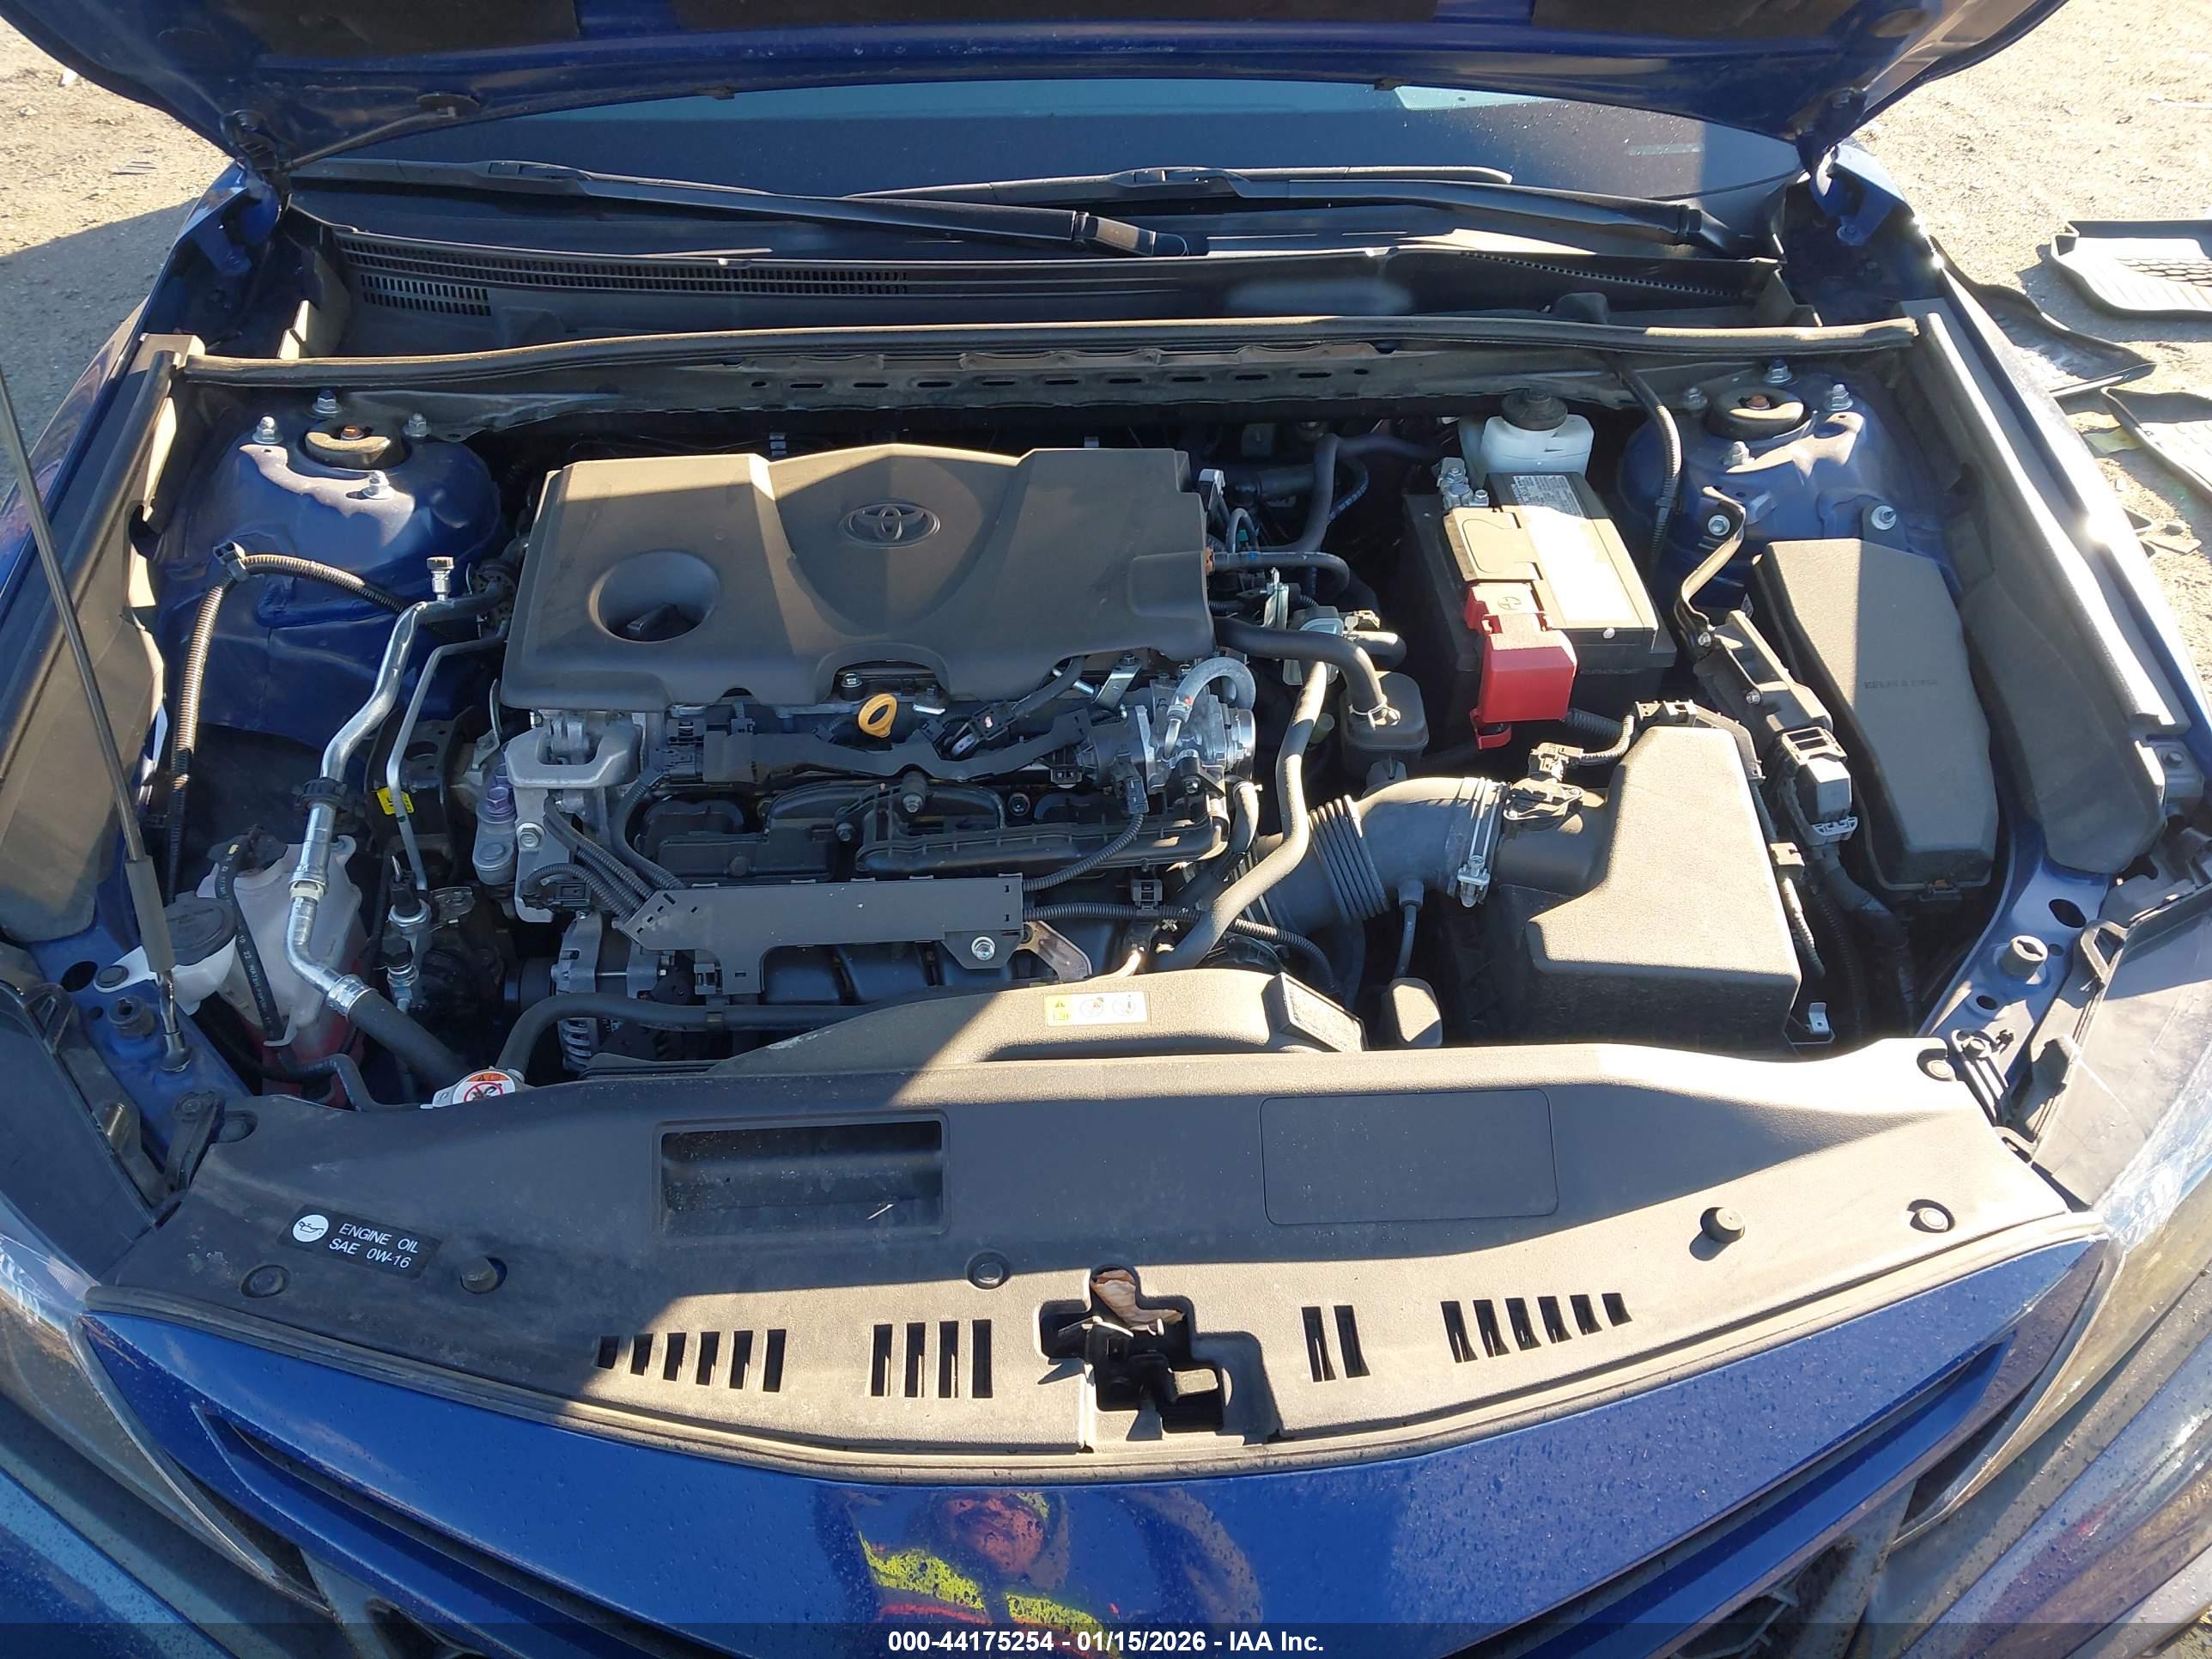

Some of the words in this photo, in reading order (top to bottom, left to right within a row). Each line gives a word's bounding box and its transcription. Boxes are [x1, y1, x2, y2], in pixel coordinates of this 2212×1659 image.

[329, 1237, 361, 1255] SAE
[366, 1247, 412, 1268] 0W-16
[338, 1223, 392, 1246] ENGINE
[397, 1238, 419, 1254] OIL
